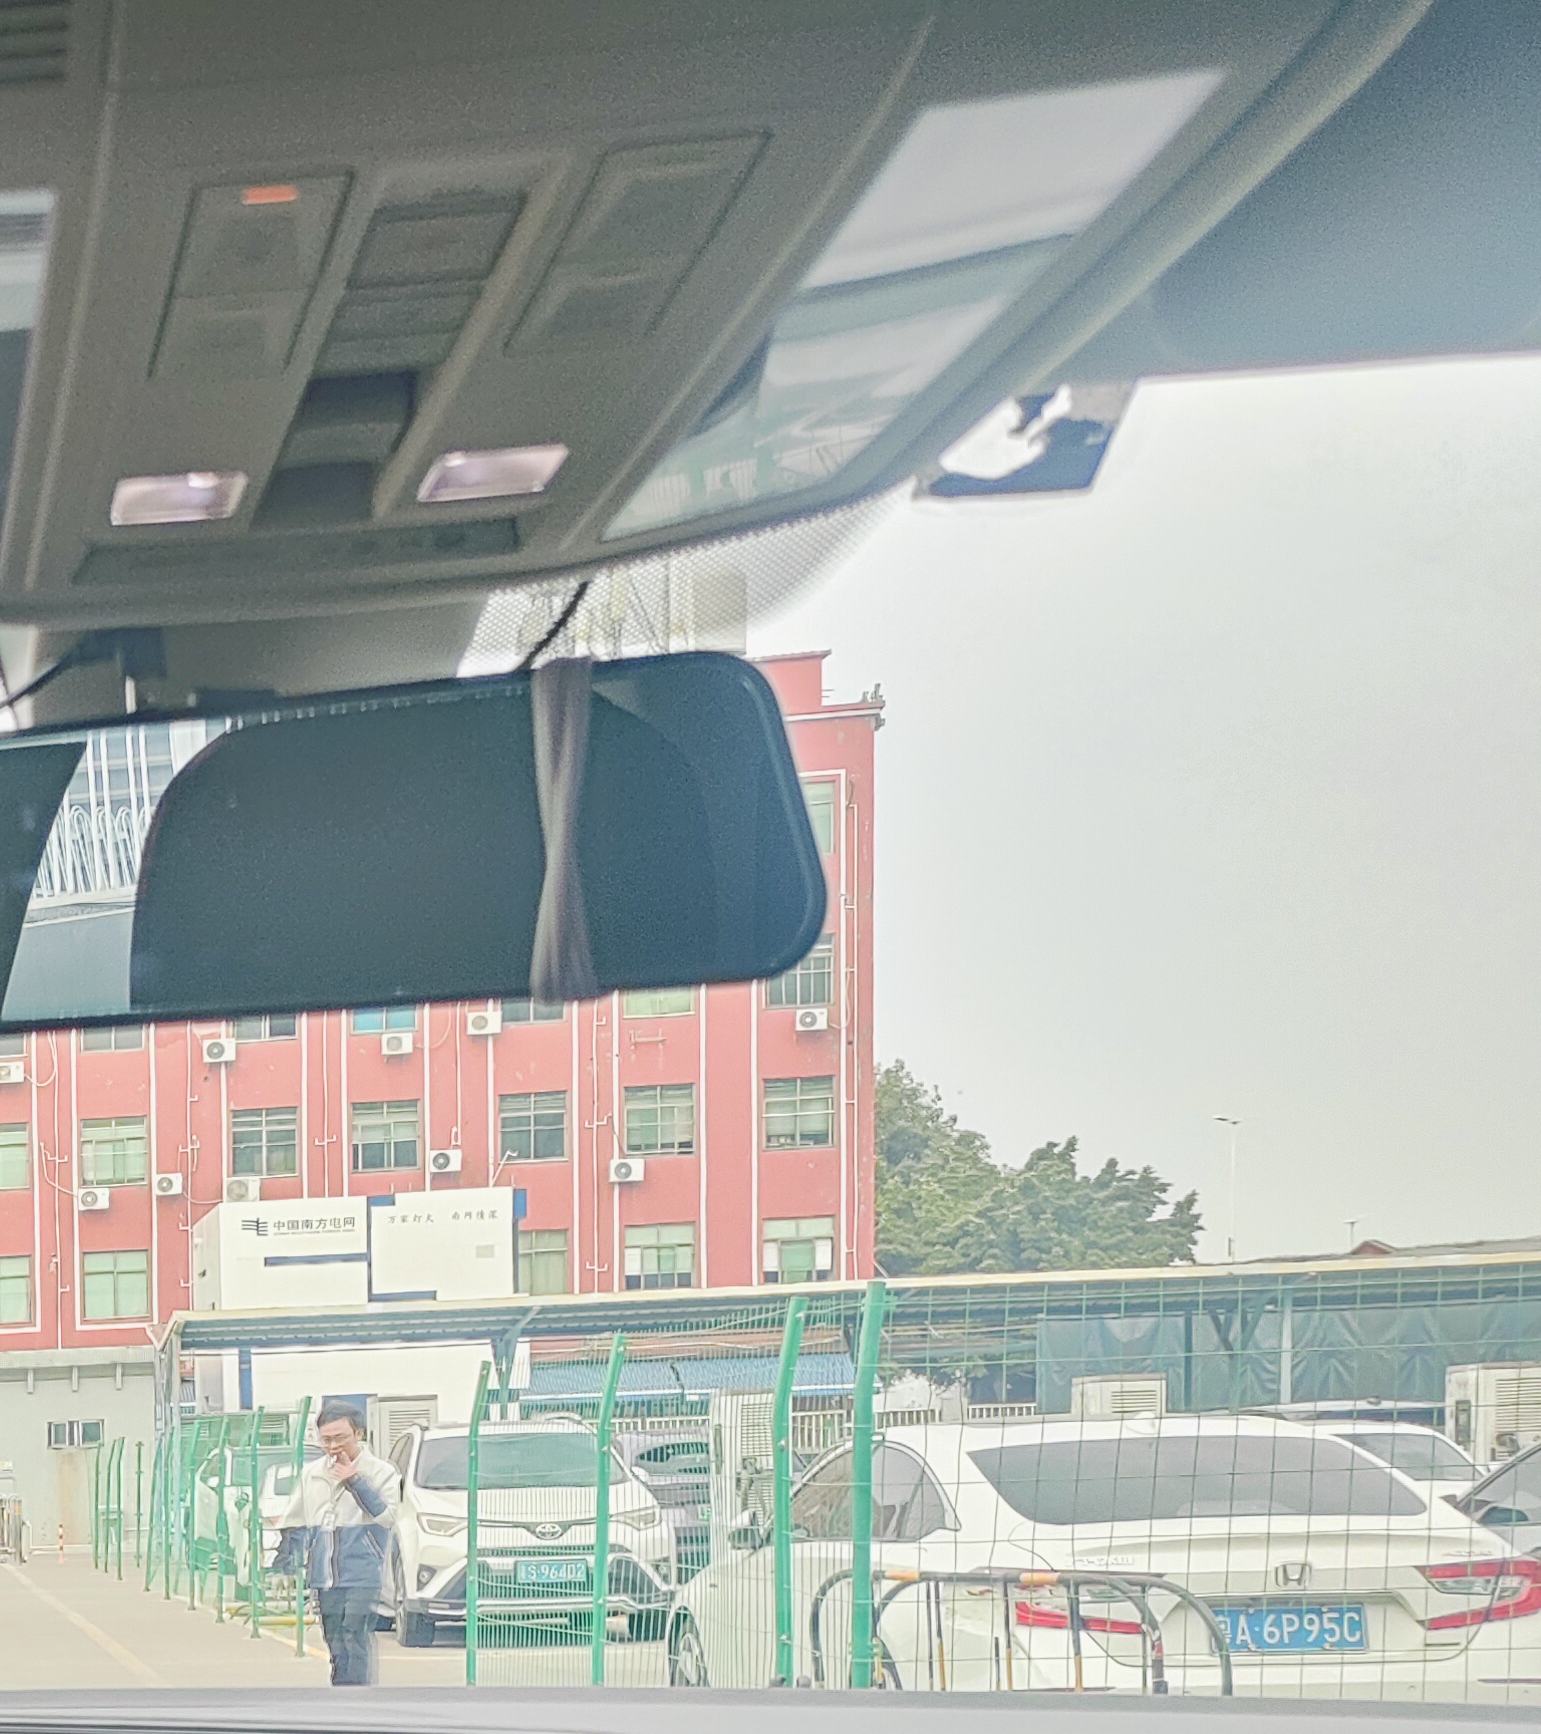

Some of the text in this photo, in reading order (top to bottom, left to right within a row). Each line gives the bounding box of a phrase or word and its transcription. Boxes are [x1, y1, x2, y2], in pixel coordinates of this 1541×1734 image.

[273, 1216, 355, 1231] 中国南方电网
